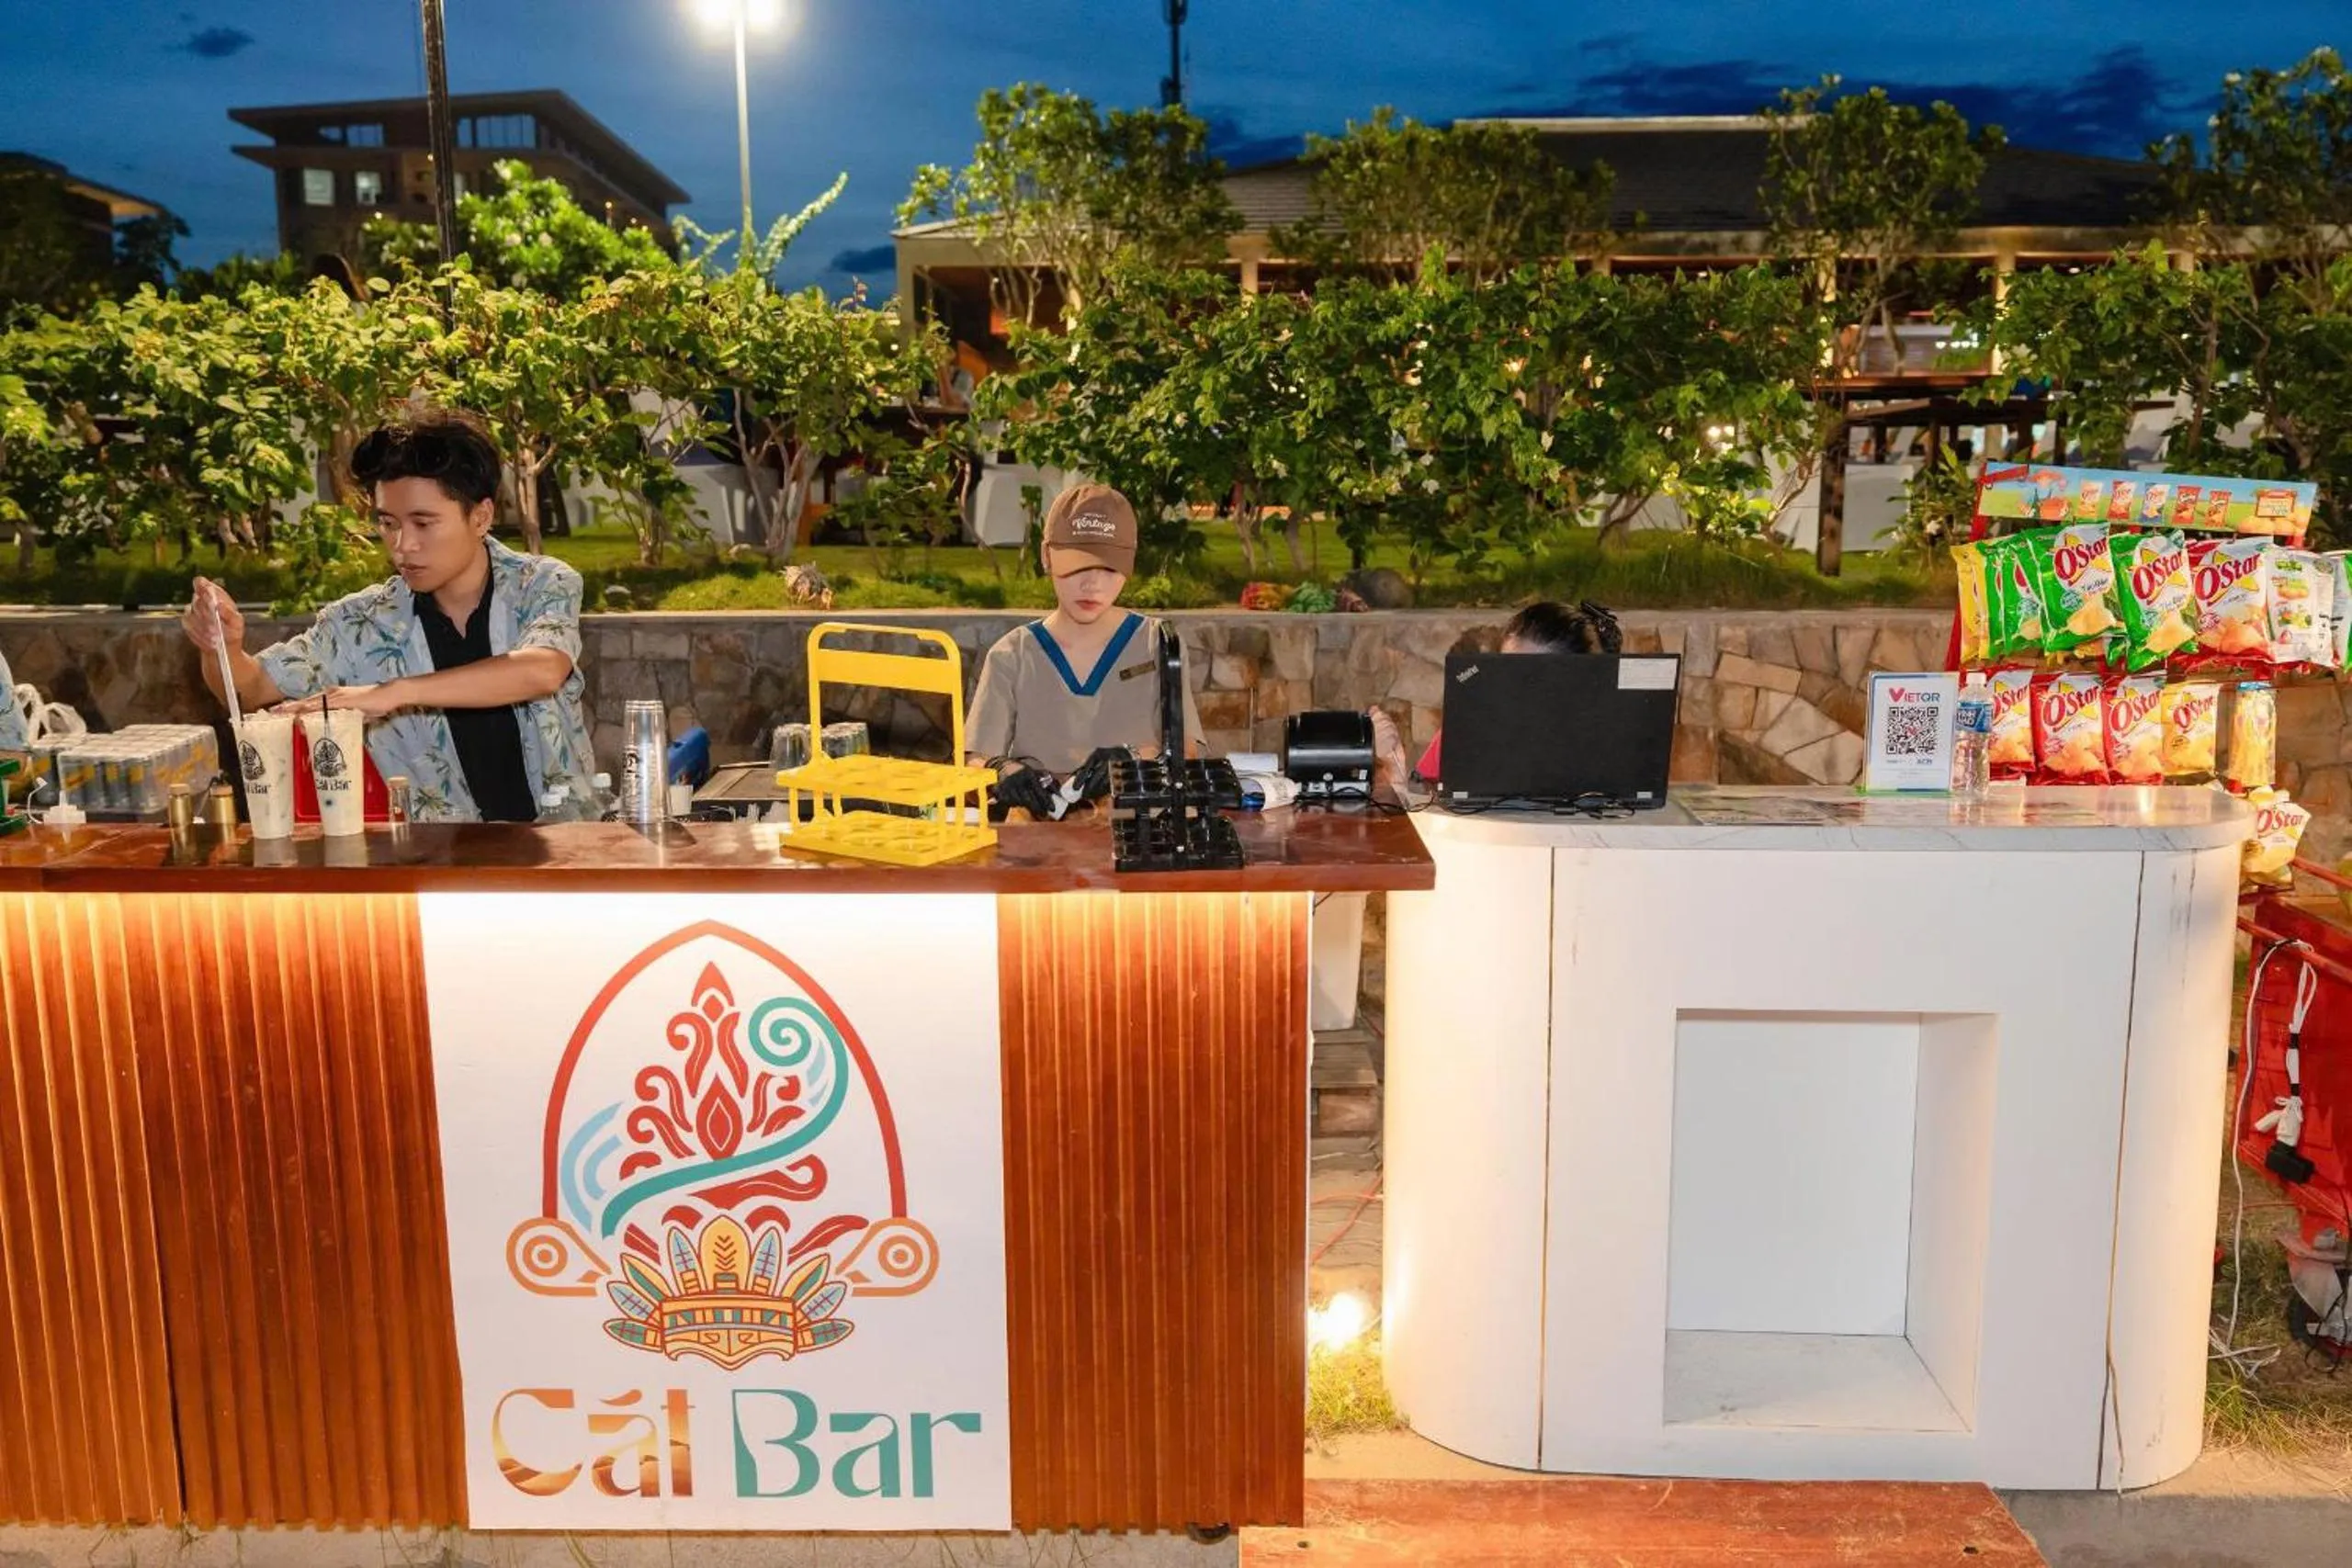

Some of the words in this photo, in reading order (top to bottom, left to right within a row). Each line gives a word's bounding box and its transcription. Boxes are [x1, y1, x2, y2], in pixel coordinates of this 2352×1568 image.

[2195, 553, 2261, 601] O'Star
[2042, 685, 2099, 727] O'Star
[2173, 694, 2214, 728] O'Star
[492, 1388, 696, 1497] Cát
[731, 1388, 982, 1498] Bar
